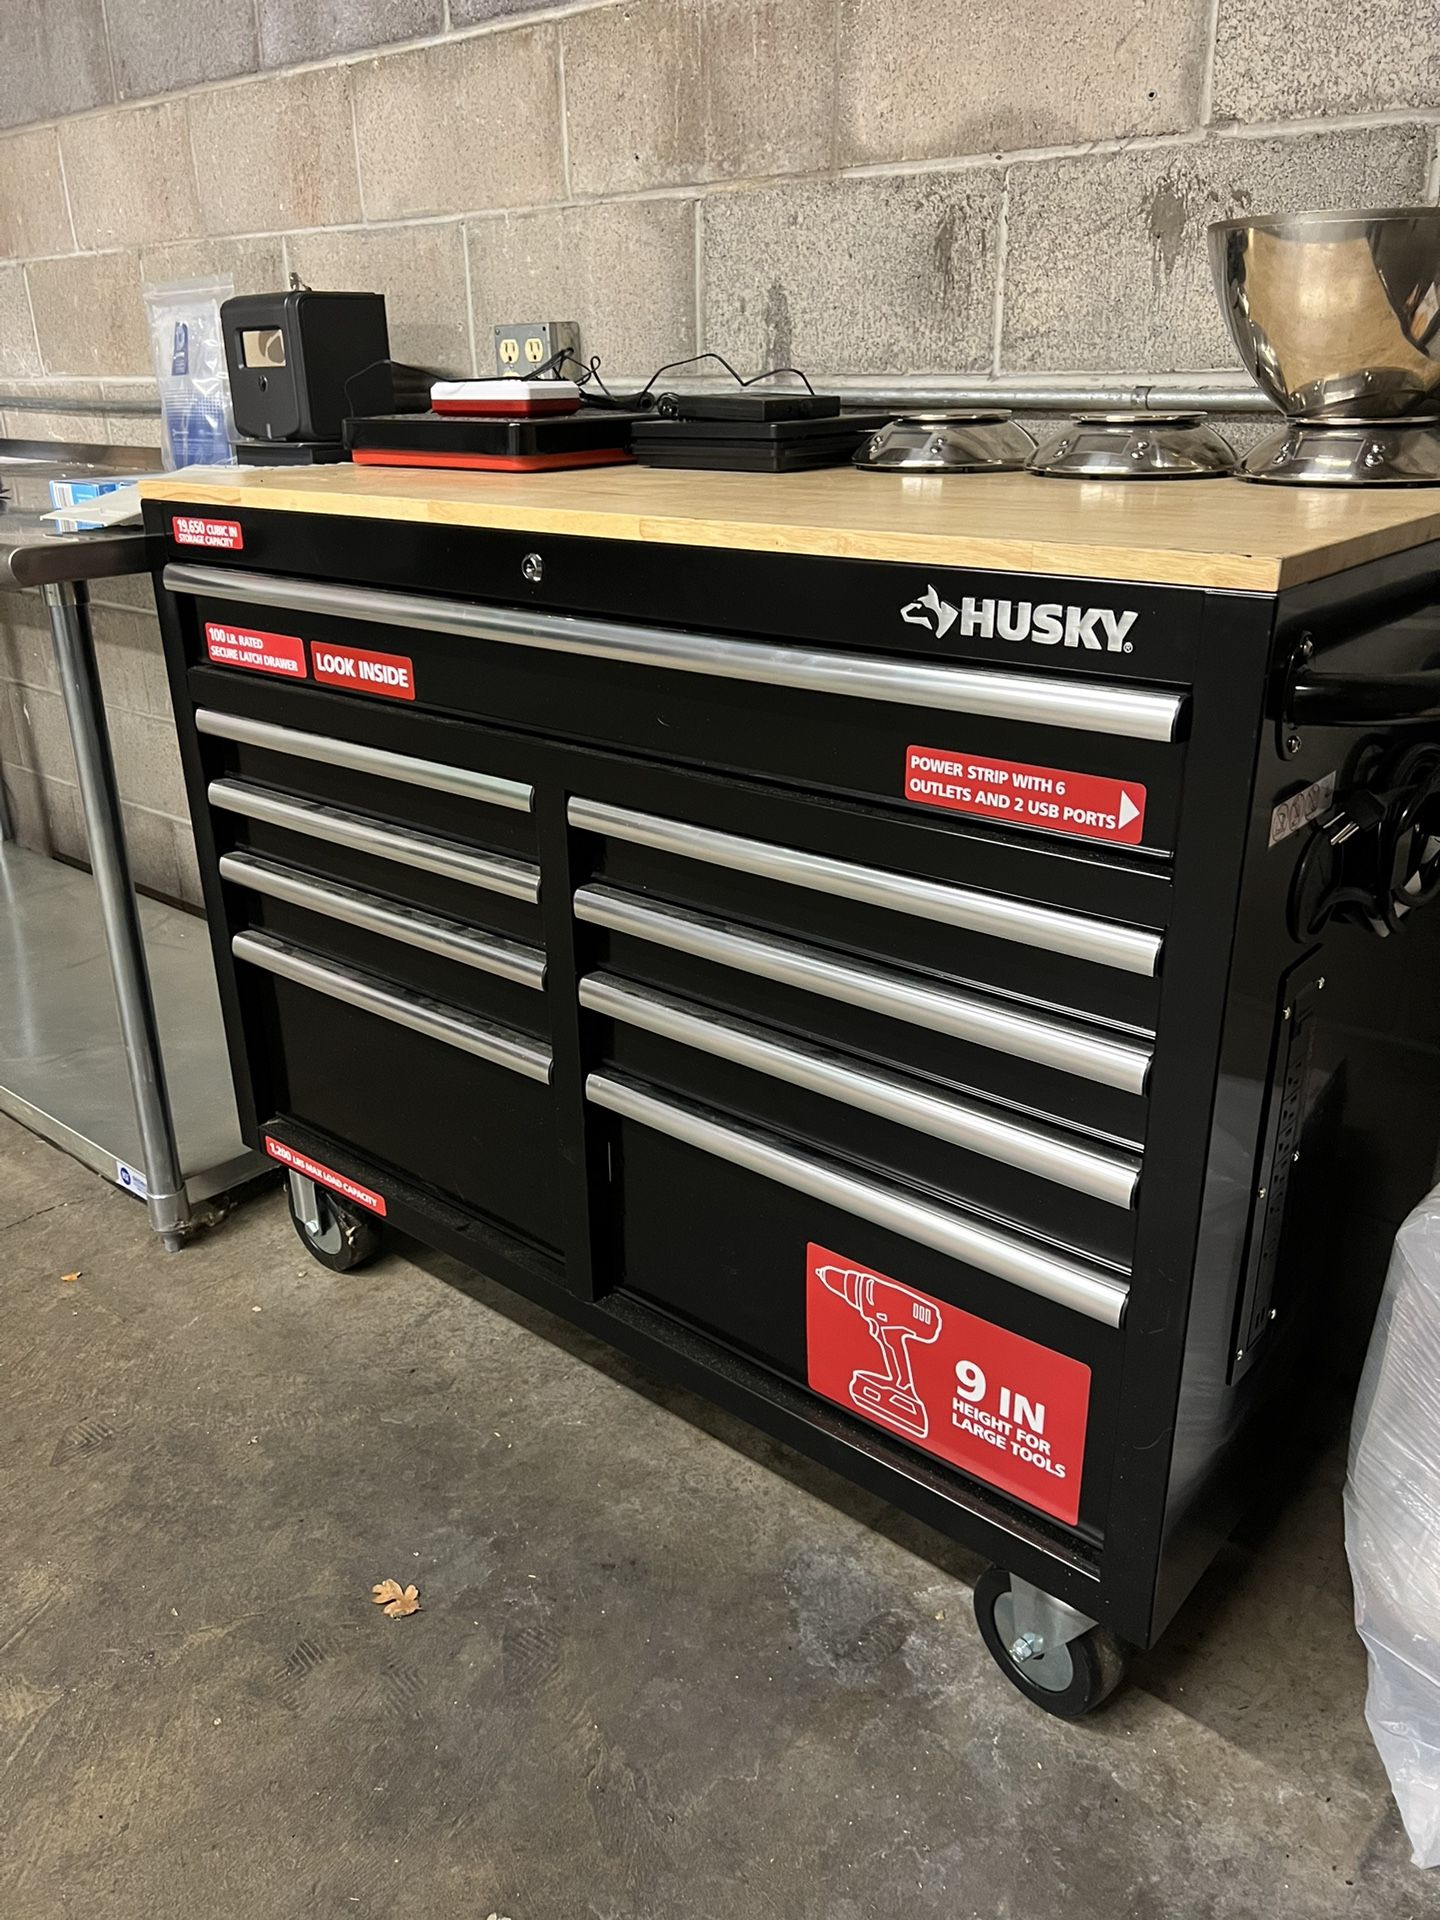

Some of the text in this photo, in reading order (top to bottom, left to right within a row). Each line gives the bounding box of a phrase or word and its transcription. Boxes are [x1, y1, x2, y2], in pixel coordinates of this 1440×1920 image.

[177, 519, 238, 537] 19,650 CUBIC IN
[178, 533, 234, 548] STORAGE CAPACITY
[208, 627, 226, 643] 100
[238, 635, 264, 650] RATED
[960, 597, 1139, 653] HUSKY
[210, 645, 299, 672] SECURE LATCH DRAWER
[315, 652, 410, 688] LOOK INSIDE
[910, 755, 1066, 795] POWER STRIP WITH 6
[910, 778, 1116, 829] OUTLETS AND 2 USB PORTS
[305, 1162, 323, 1178] MAX
[323, 1172, 343, 1189] LOAD
[343, 1183, 377, 1207] CAPACITY
[954, 1360, 1046, 1435] 9 IN
[952, 1397, 1051, 1456] HEIGHT FOR
[952, 1413, 1067, 1479] LARGE TOOLS
